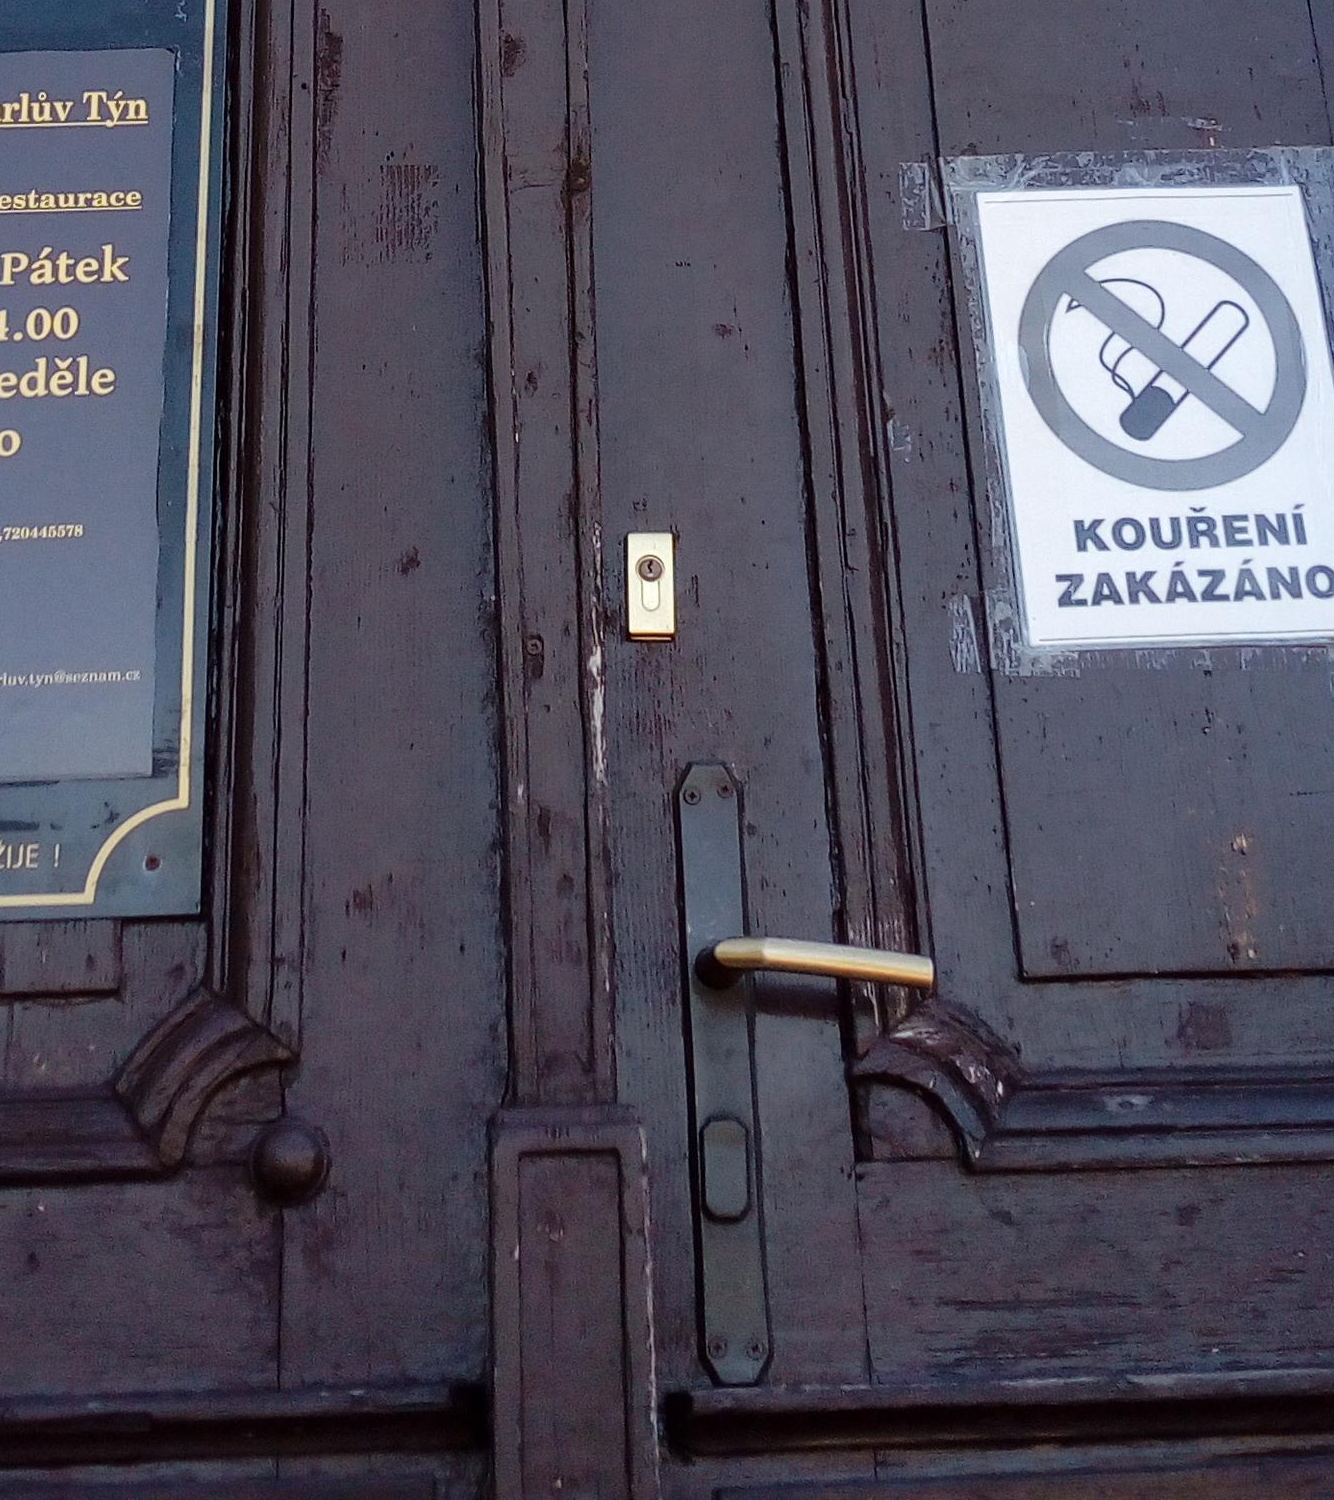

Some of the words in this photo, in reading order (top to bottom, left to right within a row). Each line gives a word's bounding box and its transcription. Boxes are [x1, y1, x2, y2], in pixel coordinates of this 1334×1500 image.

[83, 90, 148, 127] Týn
[1073, 504, 1308, 554] KOUŘENÍ
[52, 844, 61, 868] !
